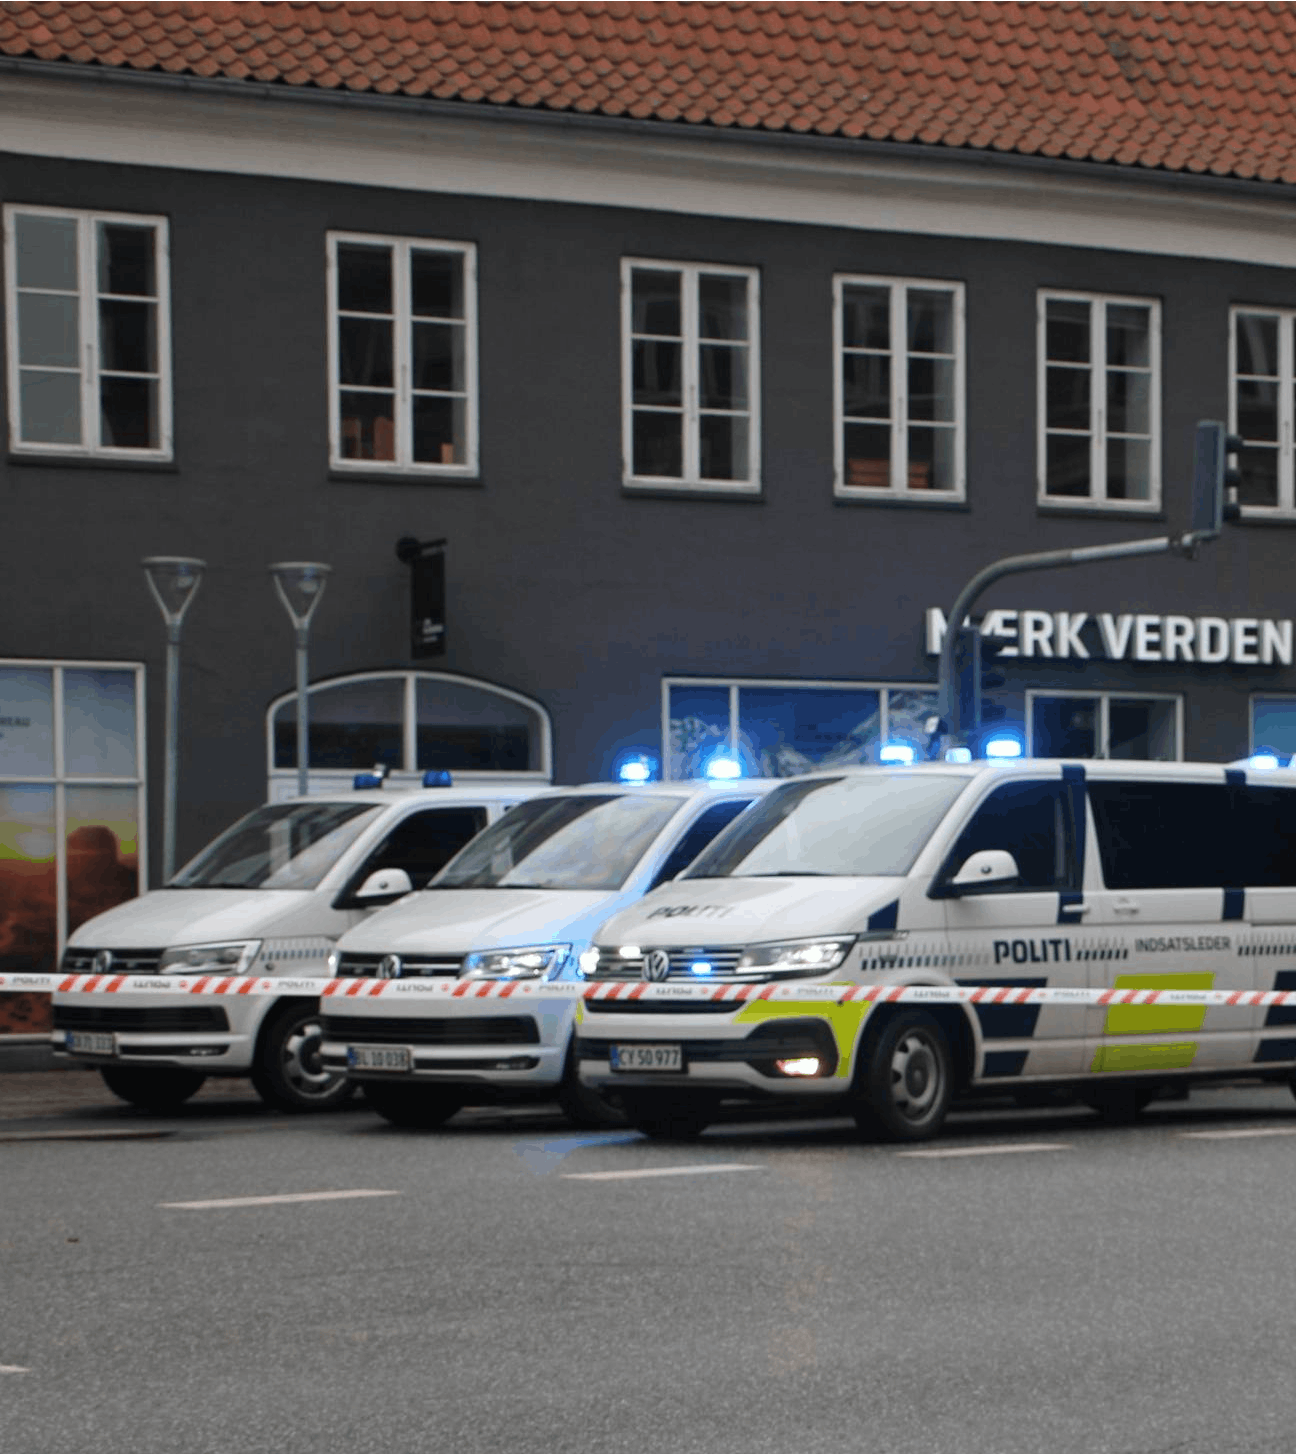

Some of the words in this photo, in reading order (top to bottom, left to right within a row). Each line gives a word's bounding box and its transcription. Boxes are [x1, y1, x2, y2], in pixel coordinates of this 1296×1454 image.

[1098, 613, 1293, 665] VERDEN
[647, 904, 735, 920] POLITI
[993, 939, 1072, 965] POLITI
[1134, 936, 1231, 952] INDSATSLEDER
[618, 1048, 635, 1066] CY
[637, 1049, 653, 1066] 50
[655, 1049, 680, 1066] 977
